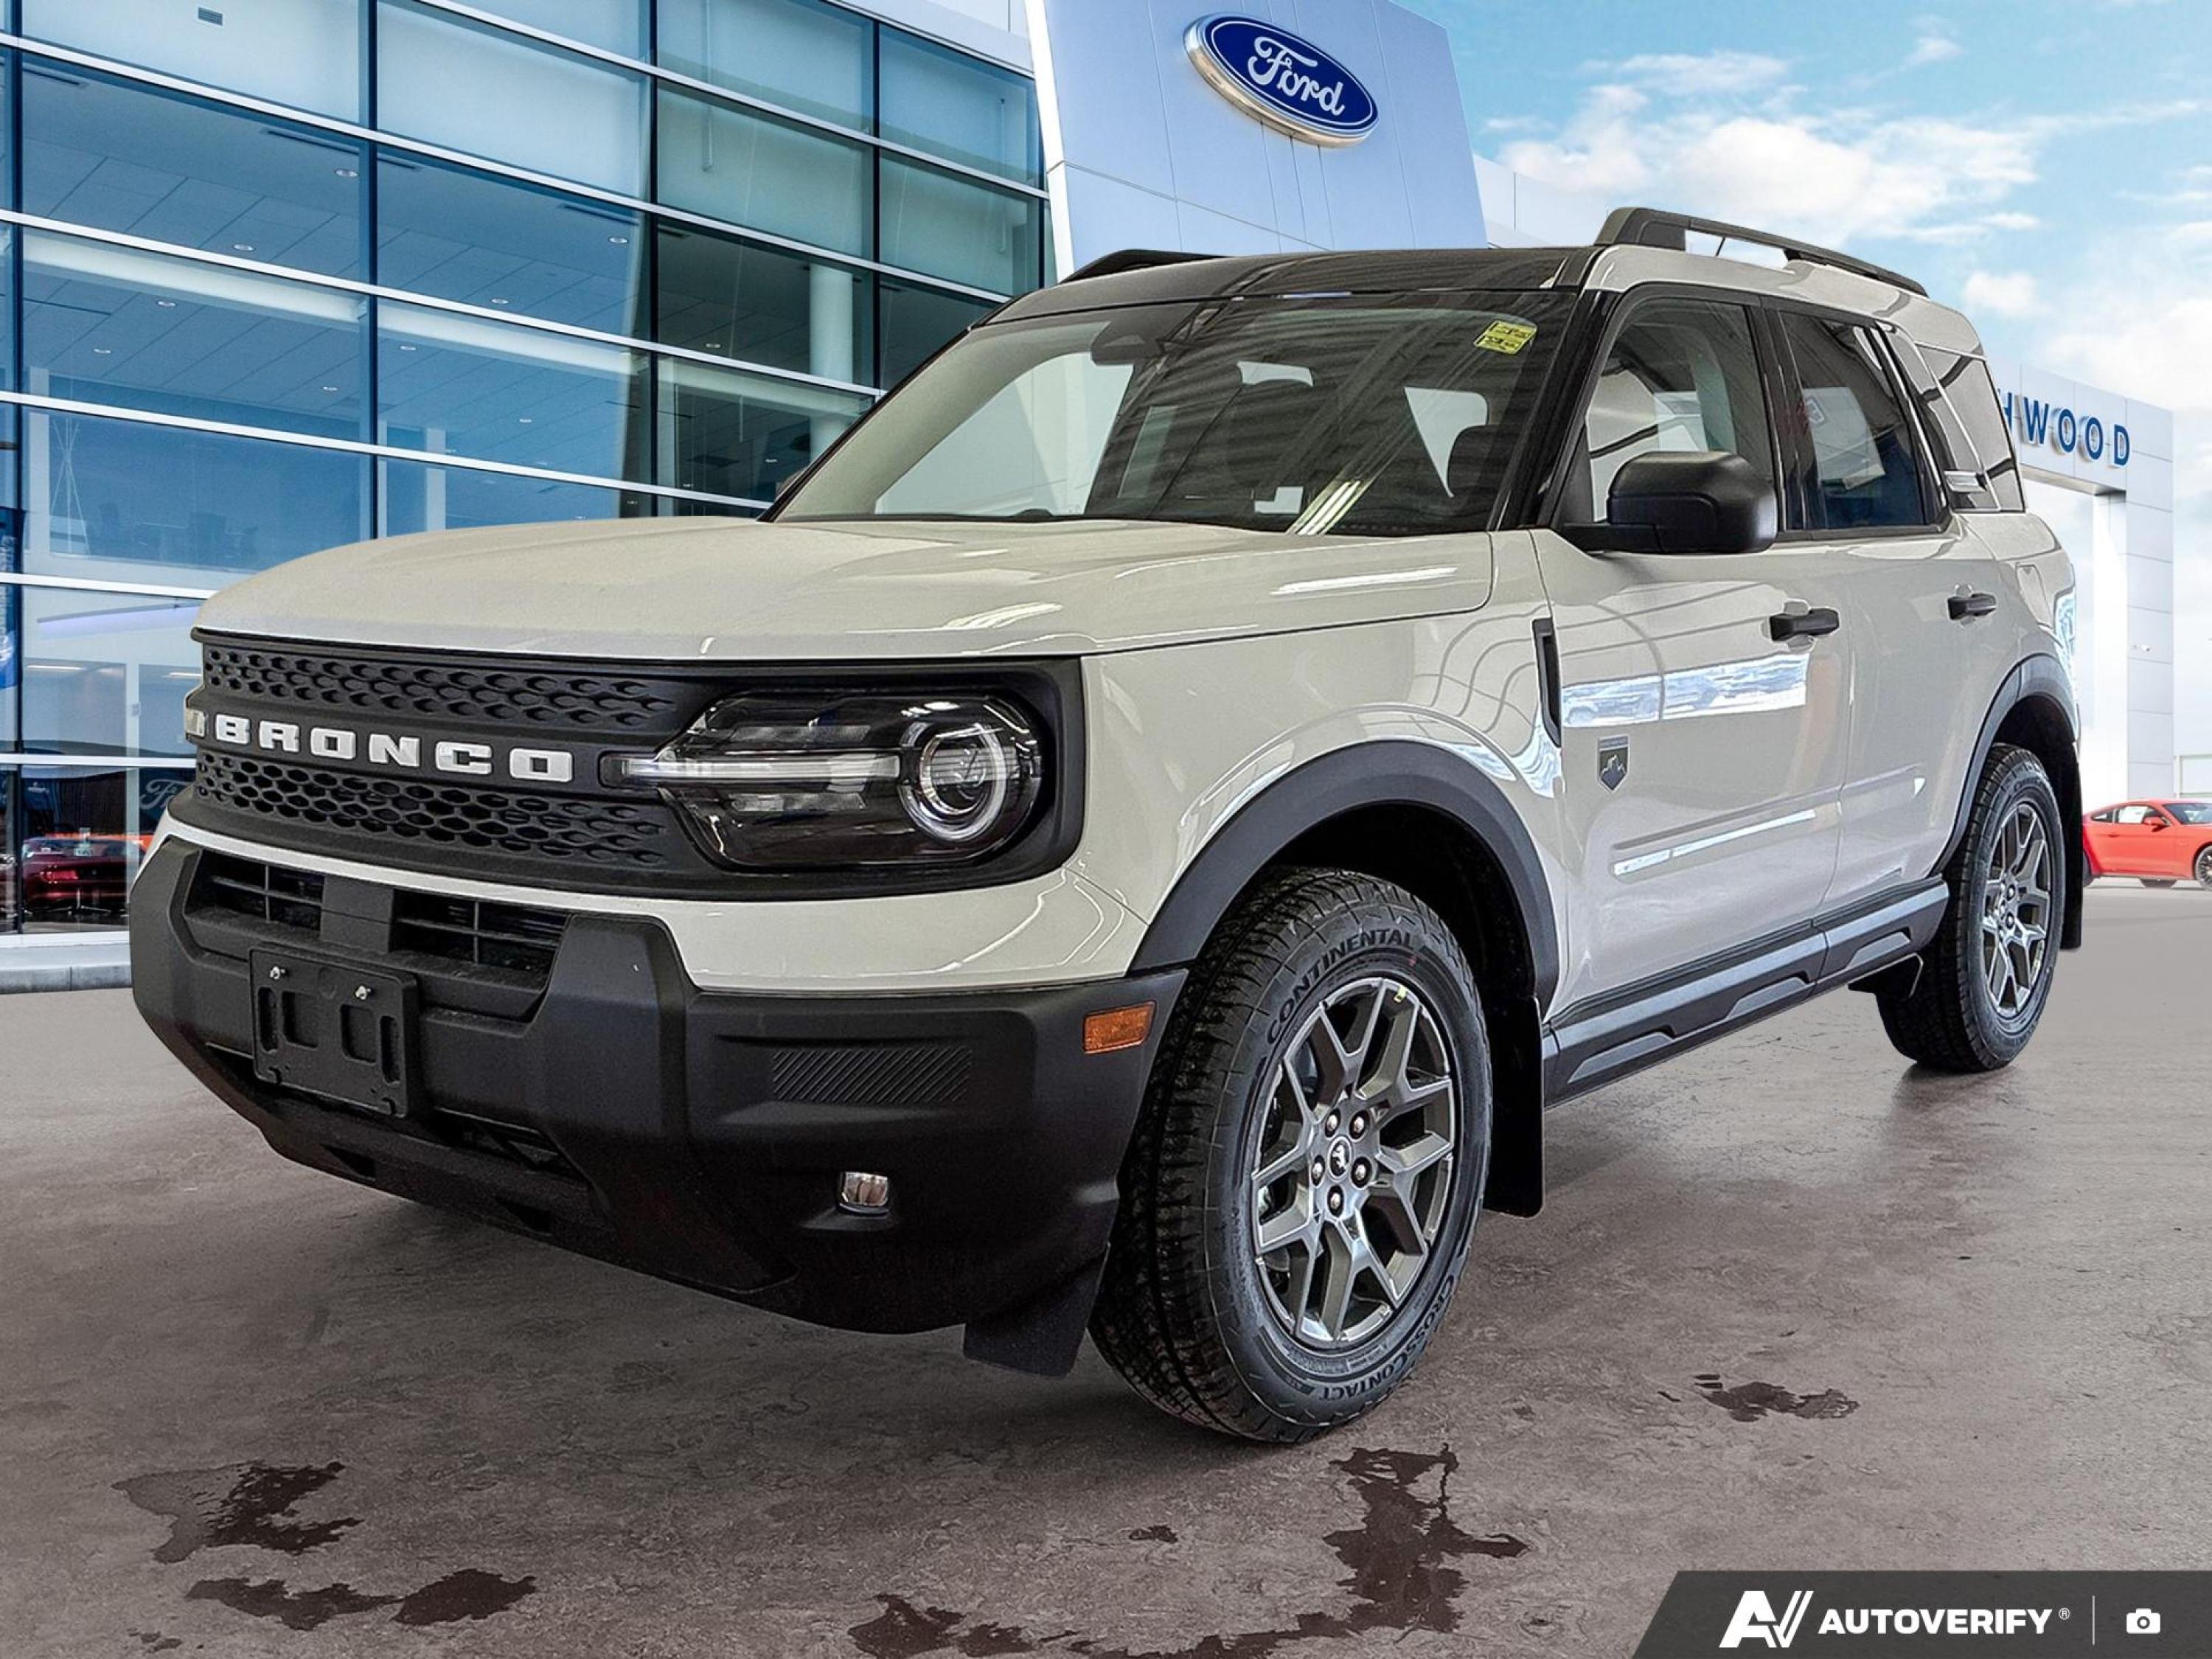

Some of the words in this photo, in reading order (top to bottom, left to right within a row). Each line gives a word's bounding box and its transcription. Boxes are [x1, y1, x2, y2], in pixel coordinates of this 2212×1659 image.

[1248, 36, 1346, 116] Ford
[215, 713, 572, 782] BRONCO
[1267, 928, 1416, 1044] CONTINENTAL
